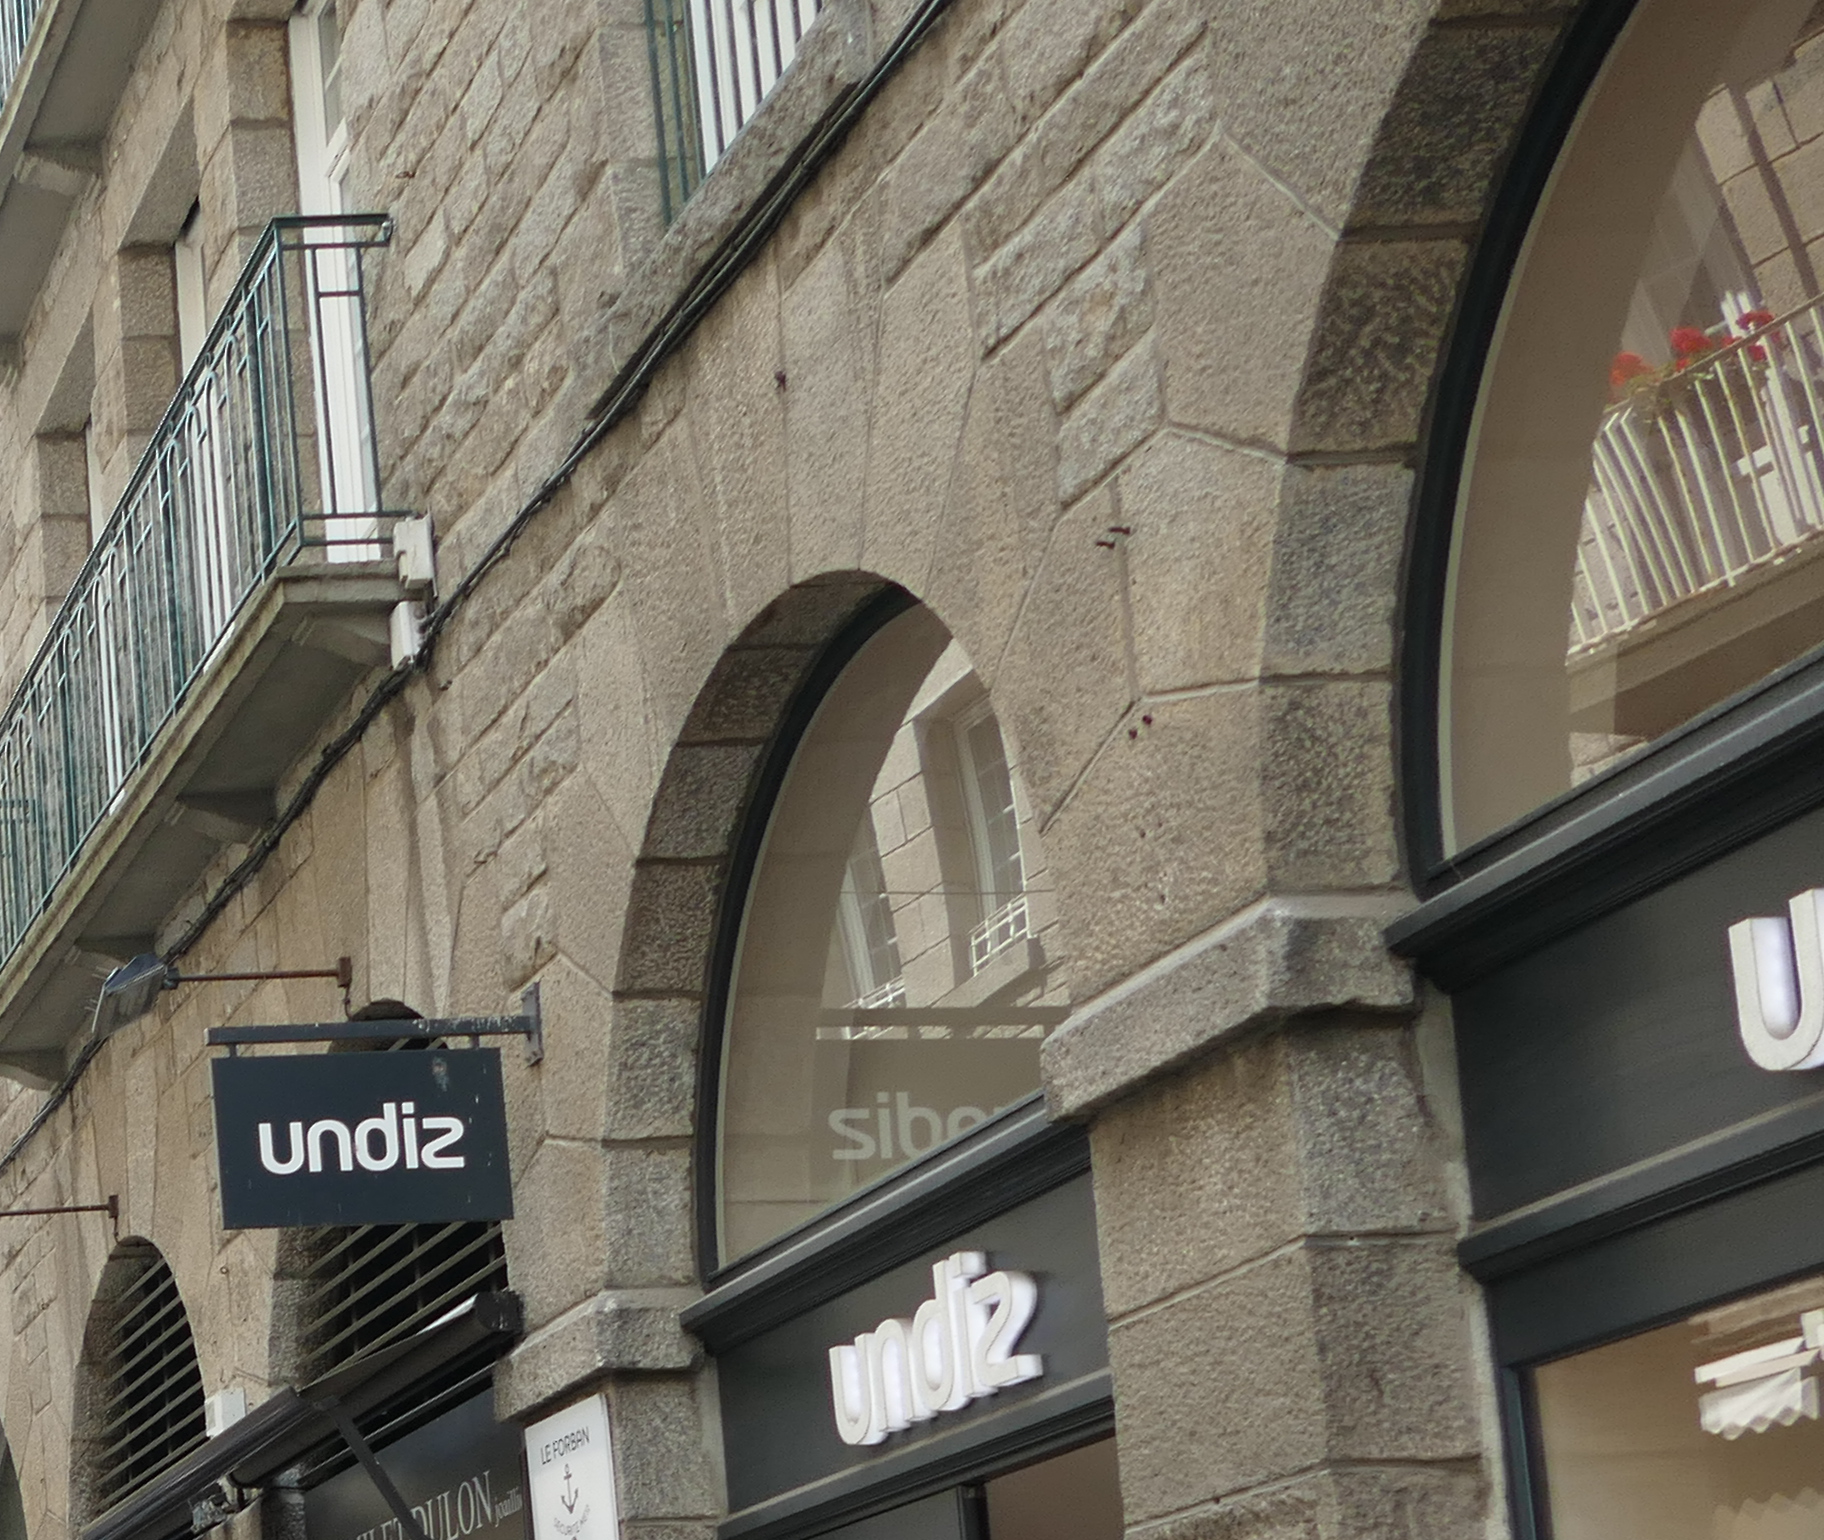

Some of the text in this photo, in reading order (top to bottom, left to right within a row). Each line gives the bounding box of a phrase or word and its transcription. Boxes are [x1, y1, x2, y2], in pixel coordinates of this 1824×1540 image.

[257, 1101, 466, 1175] undiz
[829, 1250, 1044, 1446] undiz
[541, 1426, 591, 1465] LE FORBAN
